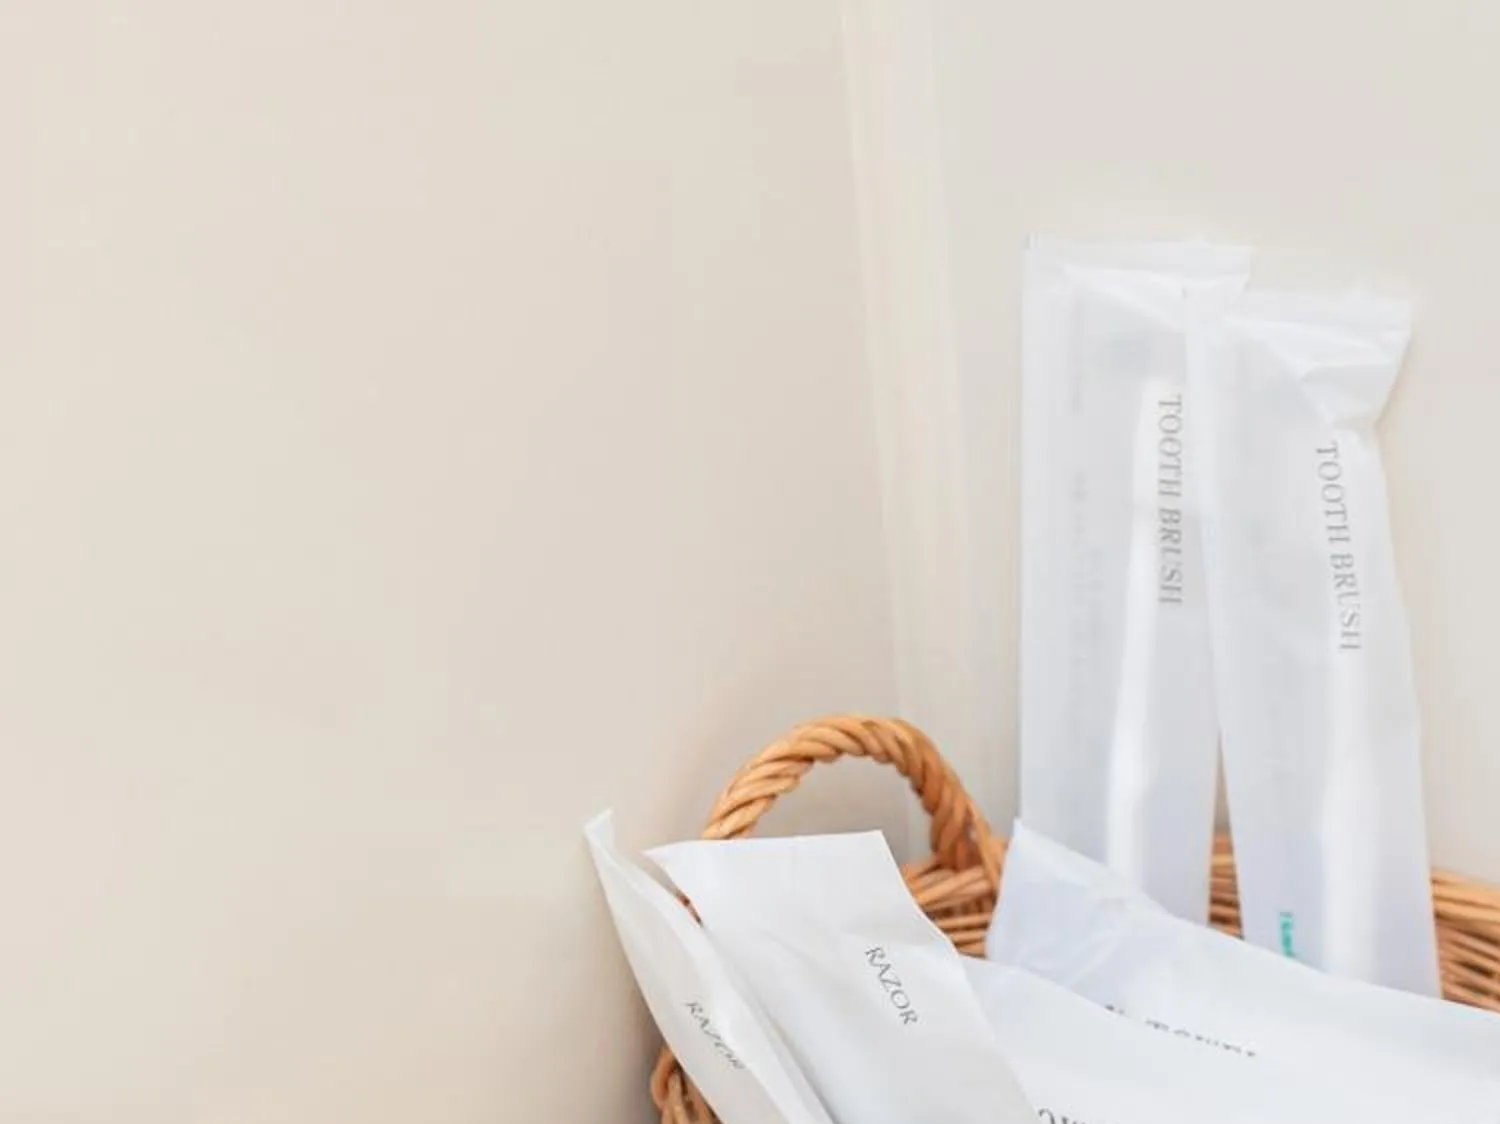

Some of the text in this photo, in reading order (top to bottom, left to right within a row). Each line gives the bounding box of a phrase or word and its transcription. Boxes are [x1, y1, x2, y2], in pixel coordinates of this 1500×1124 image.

[1157, 393, 1183, 608] TOOTH BRUSH
[1315, 440, 1362, 652] TOOTH BRUSH
[864, 947, 918, 1025] RAZOR
